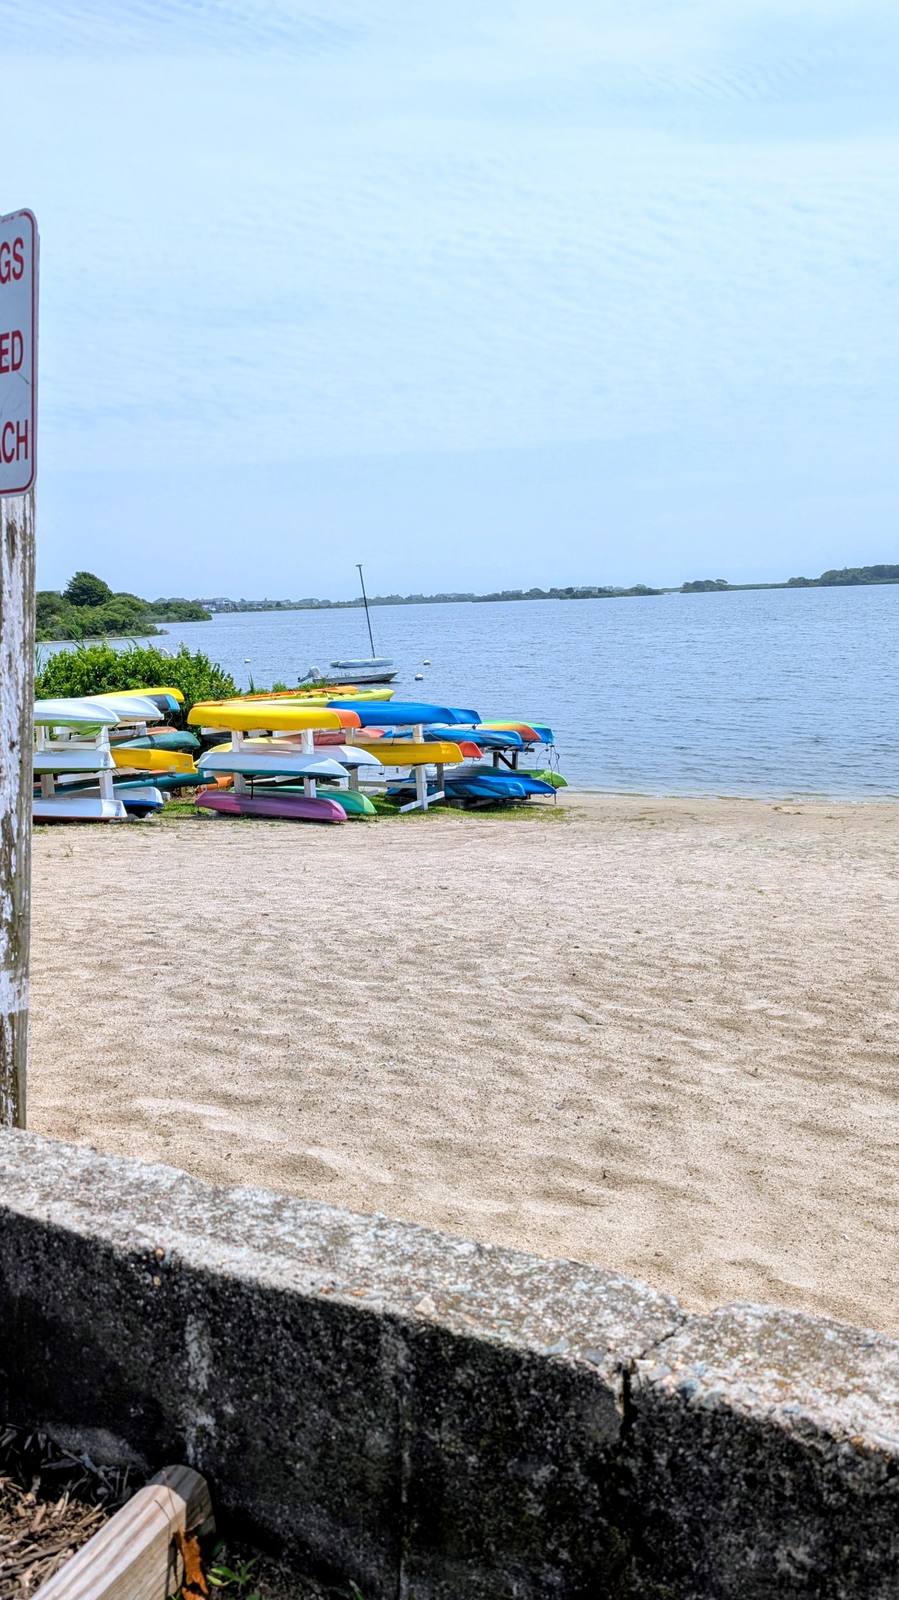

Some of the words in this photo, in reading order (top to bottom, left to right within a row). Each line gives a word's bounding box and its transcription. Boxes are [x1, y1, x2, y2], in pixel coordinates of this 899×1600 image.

[0, 237, 24, 284] GS
[0, 330, 23, 374] ED
[0, 419, 28, 464] CH
